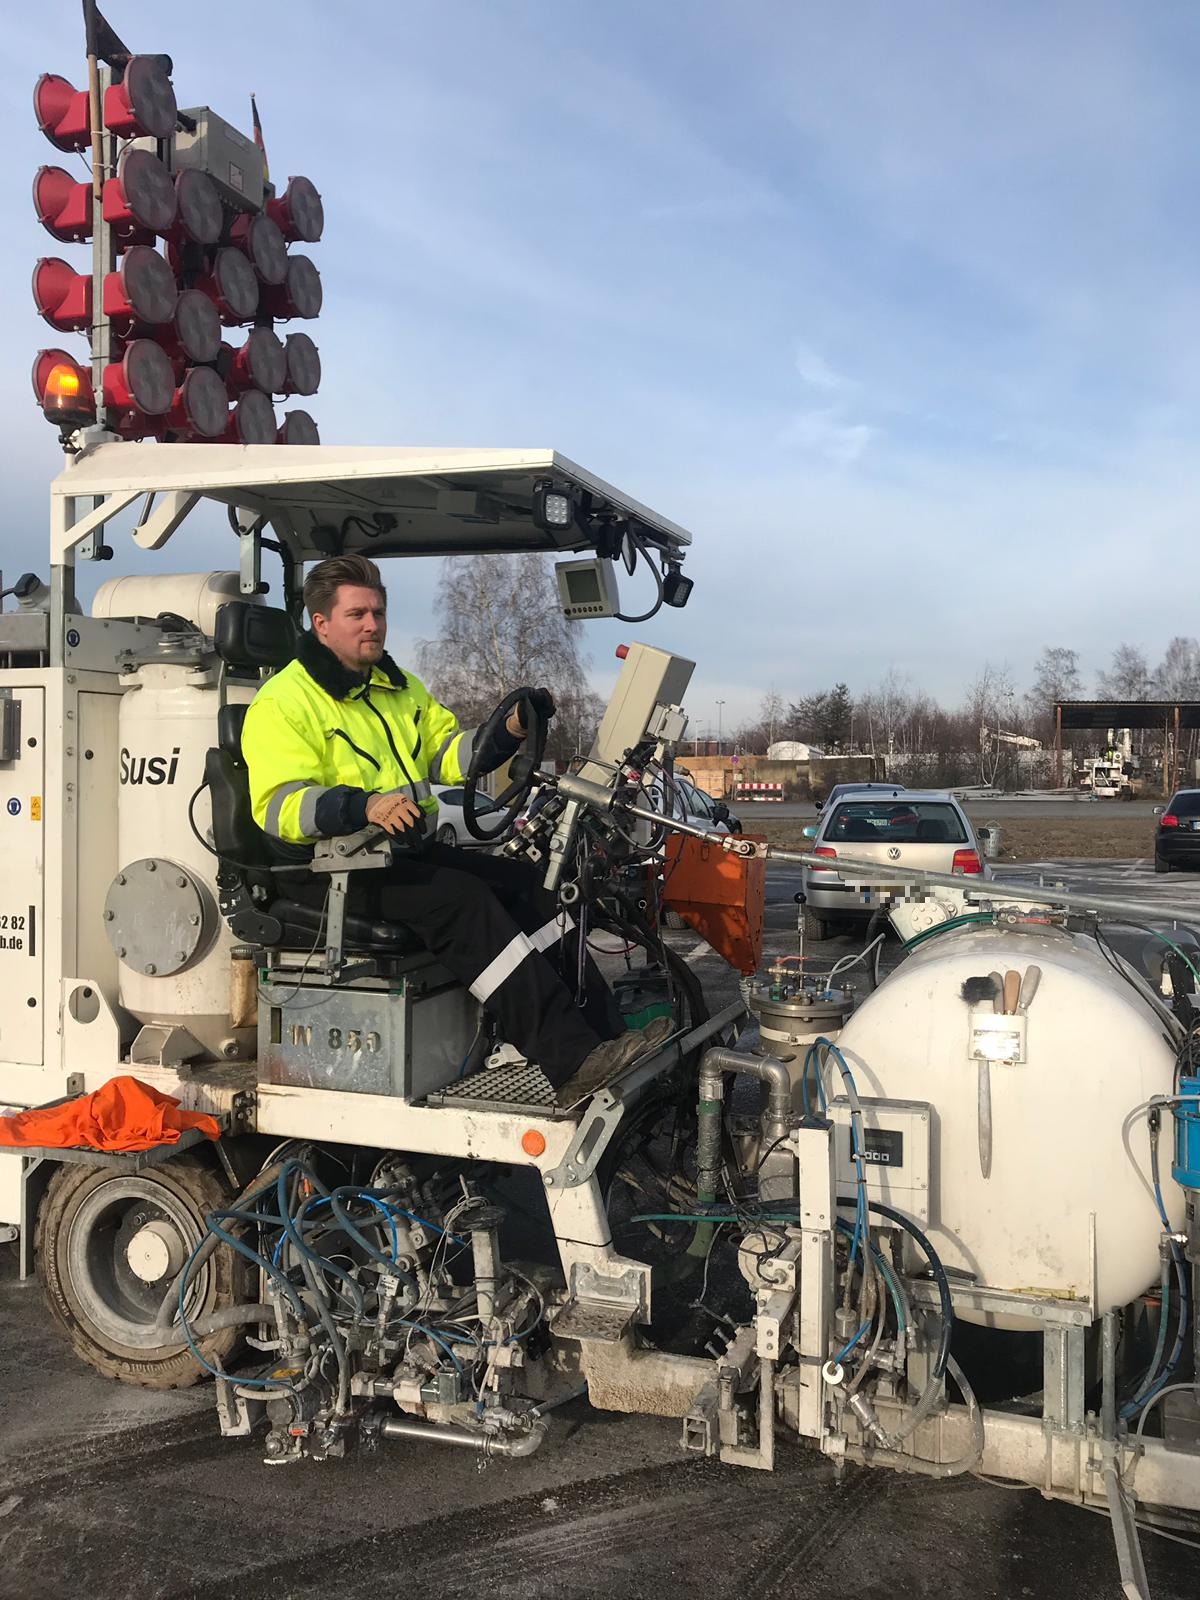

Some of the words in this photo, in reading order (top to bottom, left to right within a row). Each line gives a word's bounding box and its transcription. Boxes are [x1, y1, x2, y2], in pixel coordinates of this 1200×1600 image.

[120, 747, 181, 785] Susi
[0, 915, 8, 929] 2
[11, 915, 25, 930] 82
